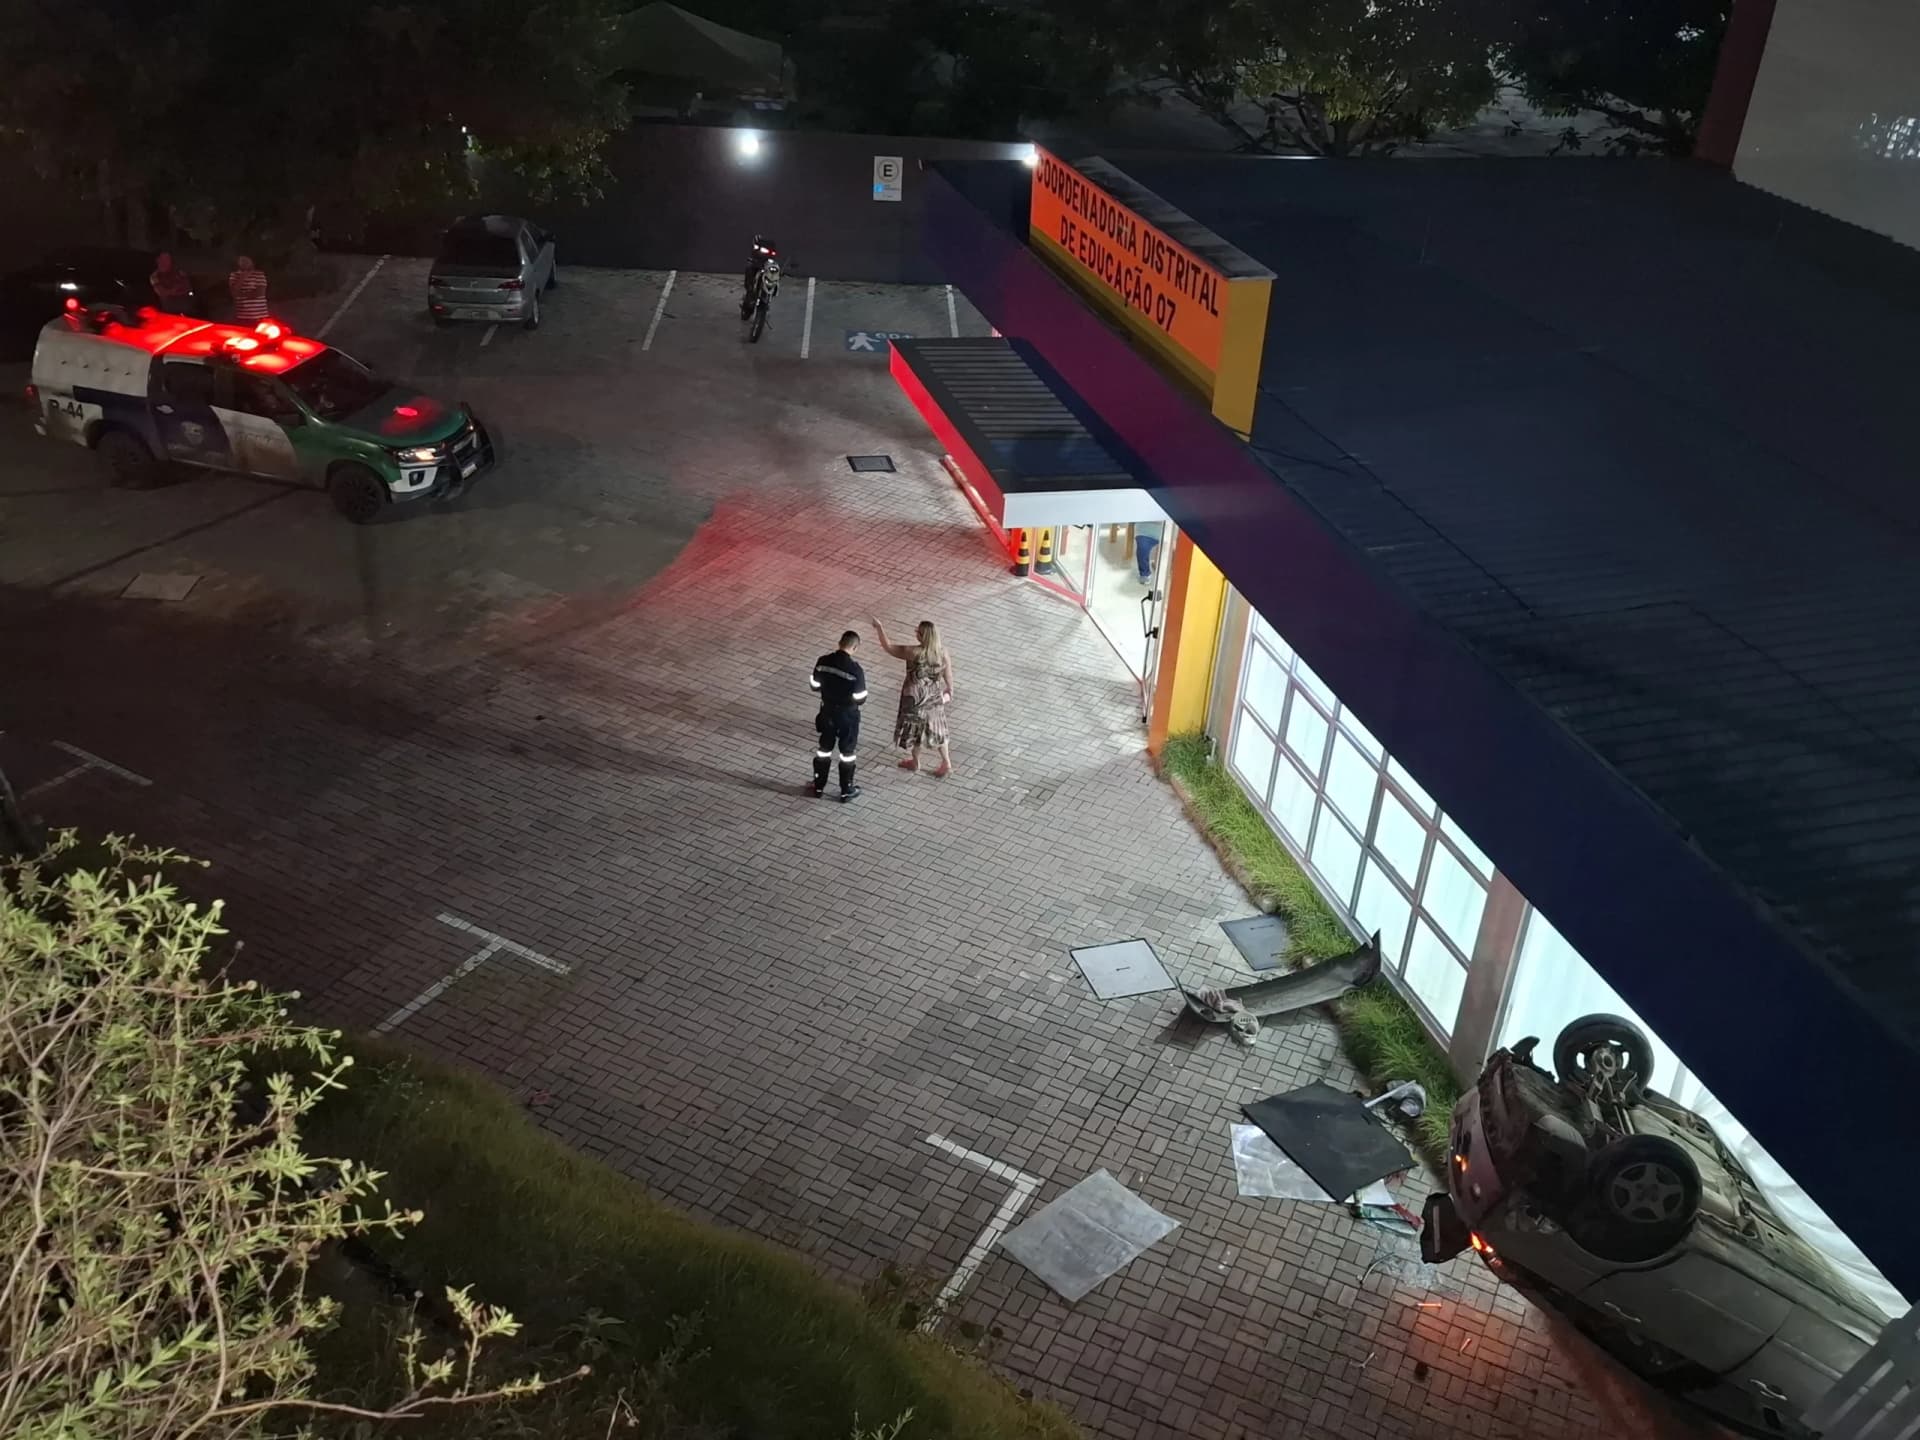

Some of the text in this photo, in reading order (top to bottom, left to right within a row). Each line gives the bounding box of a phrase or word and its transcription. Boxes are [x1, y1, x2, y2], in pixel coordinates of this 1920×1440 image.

[883, 164, 893, 177] E
[1036, 157, 1219, 318] COORDENADORIA DISTRITAL
[1060, 215, 1177, 332] DE EDUCAÇÃO 07
